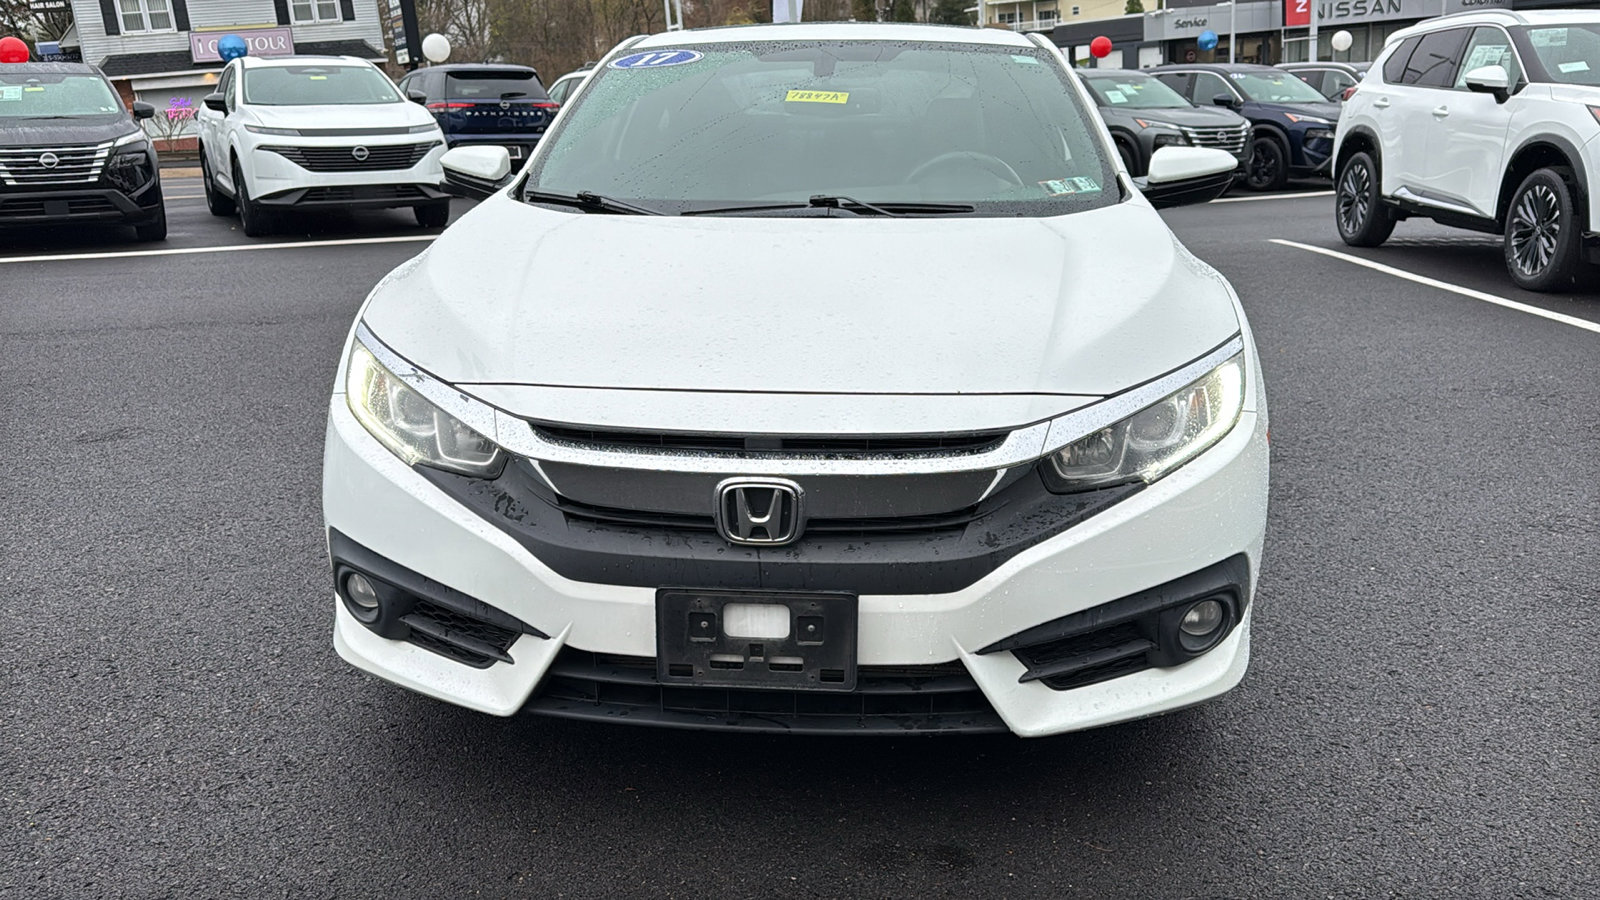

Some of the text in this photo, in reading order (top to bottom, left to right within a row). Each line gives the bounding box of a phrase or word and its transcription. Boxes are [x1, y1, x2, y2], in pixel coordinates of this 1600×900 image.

[1174, 17, 1208, 29] Service
[208, 35, 286, 54] CTOUR
[631, 51, 681, 66] 17
